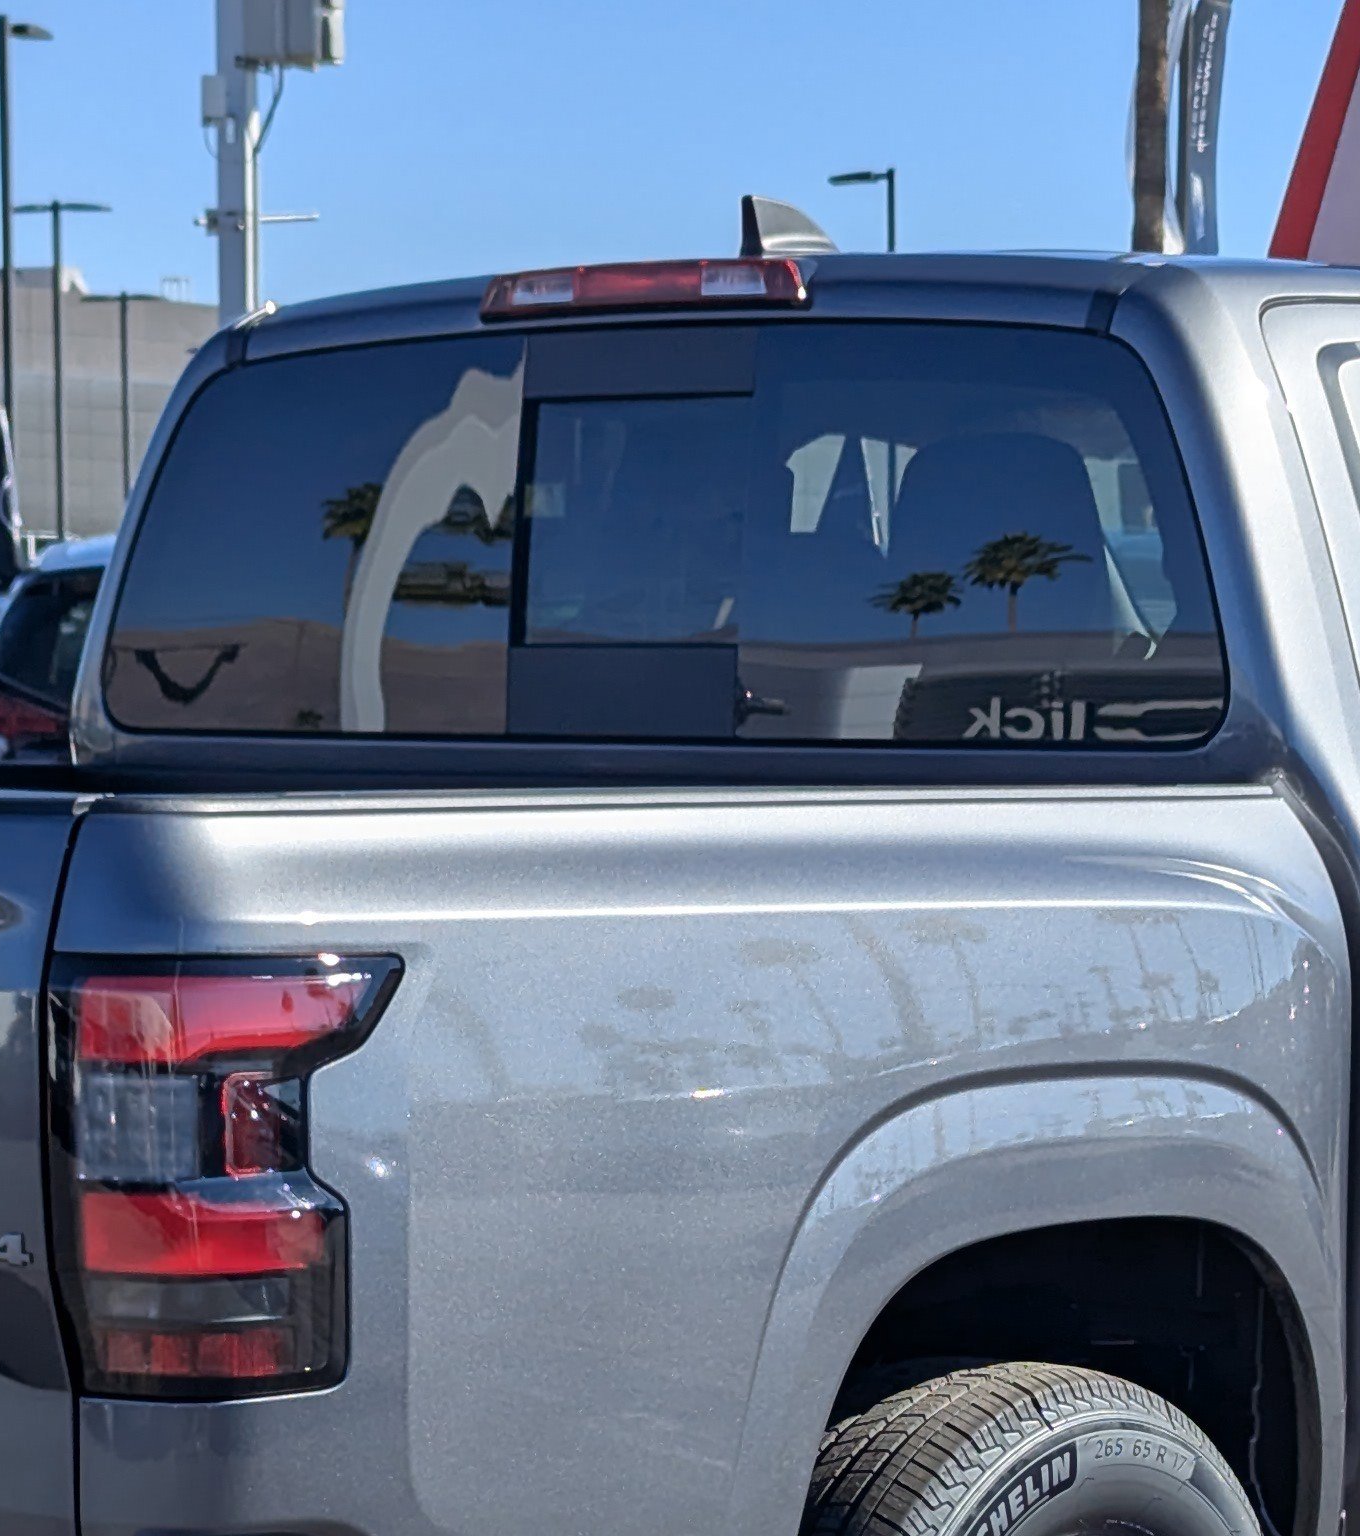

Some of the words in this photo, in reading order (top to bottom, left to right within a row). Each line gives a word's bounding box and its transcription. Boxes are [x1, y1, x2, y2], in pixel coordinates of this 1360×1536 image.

[1094, 1437, 1123, 1460] 265
[1132, 1437, 1151, 1460] 65
[1155, 1445, 1168, 1464] R
